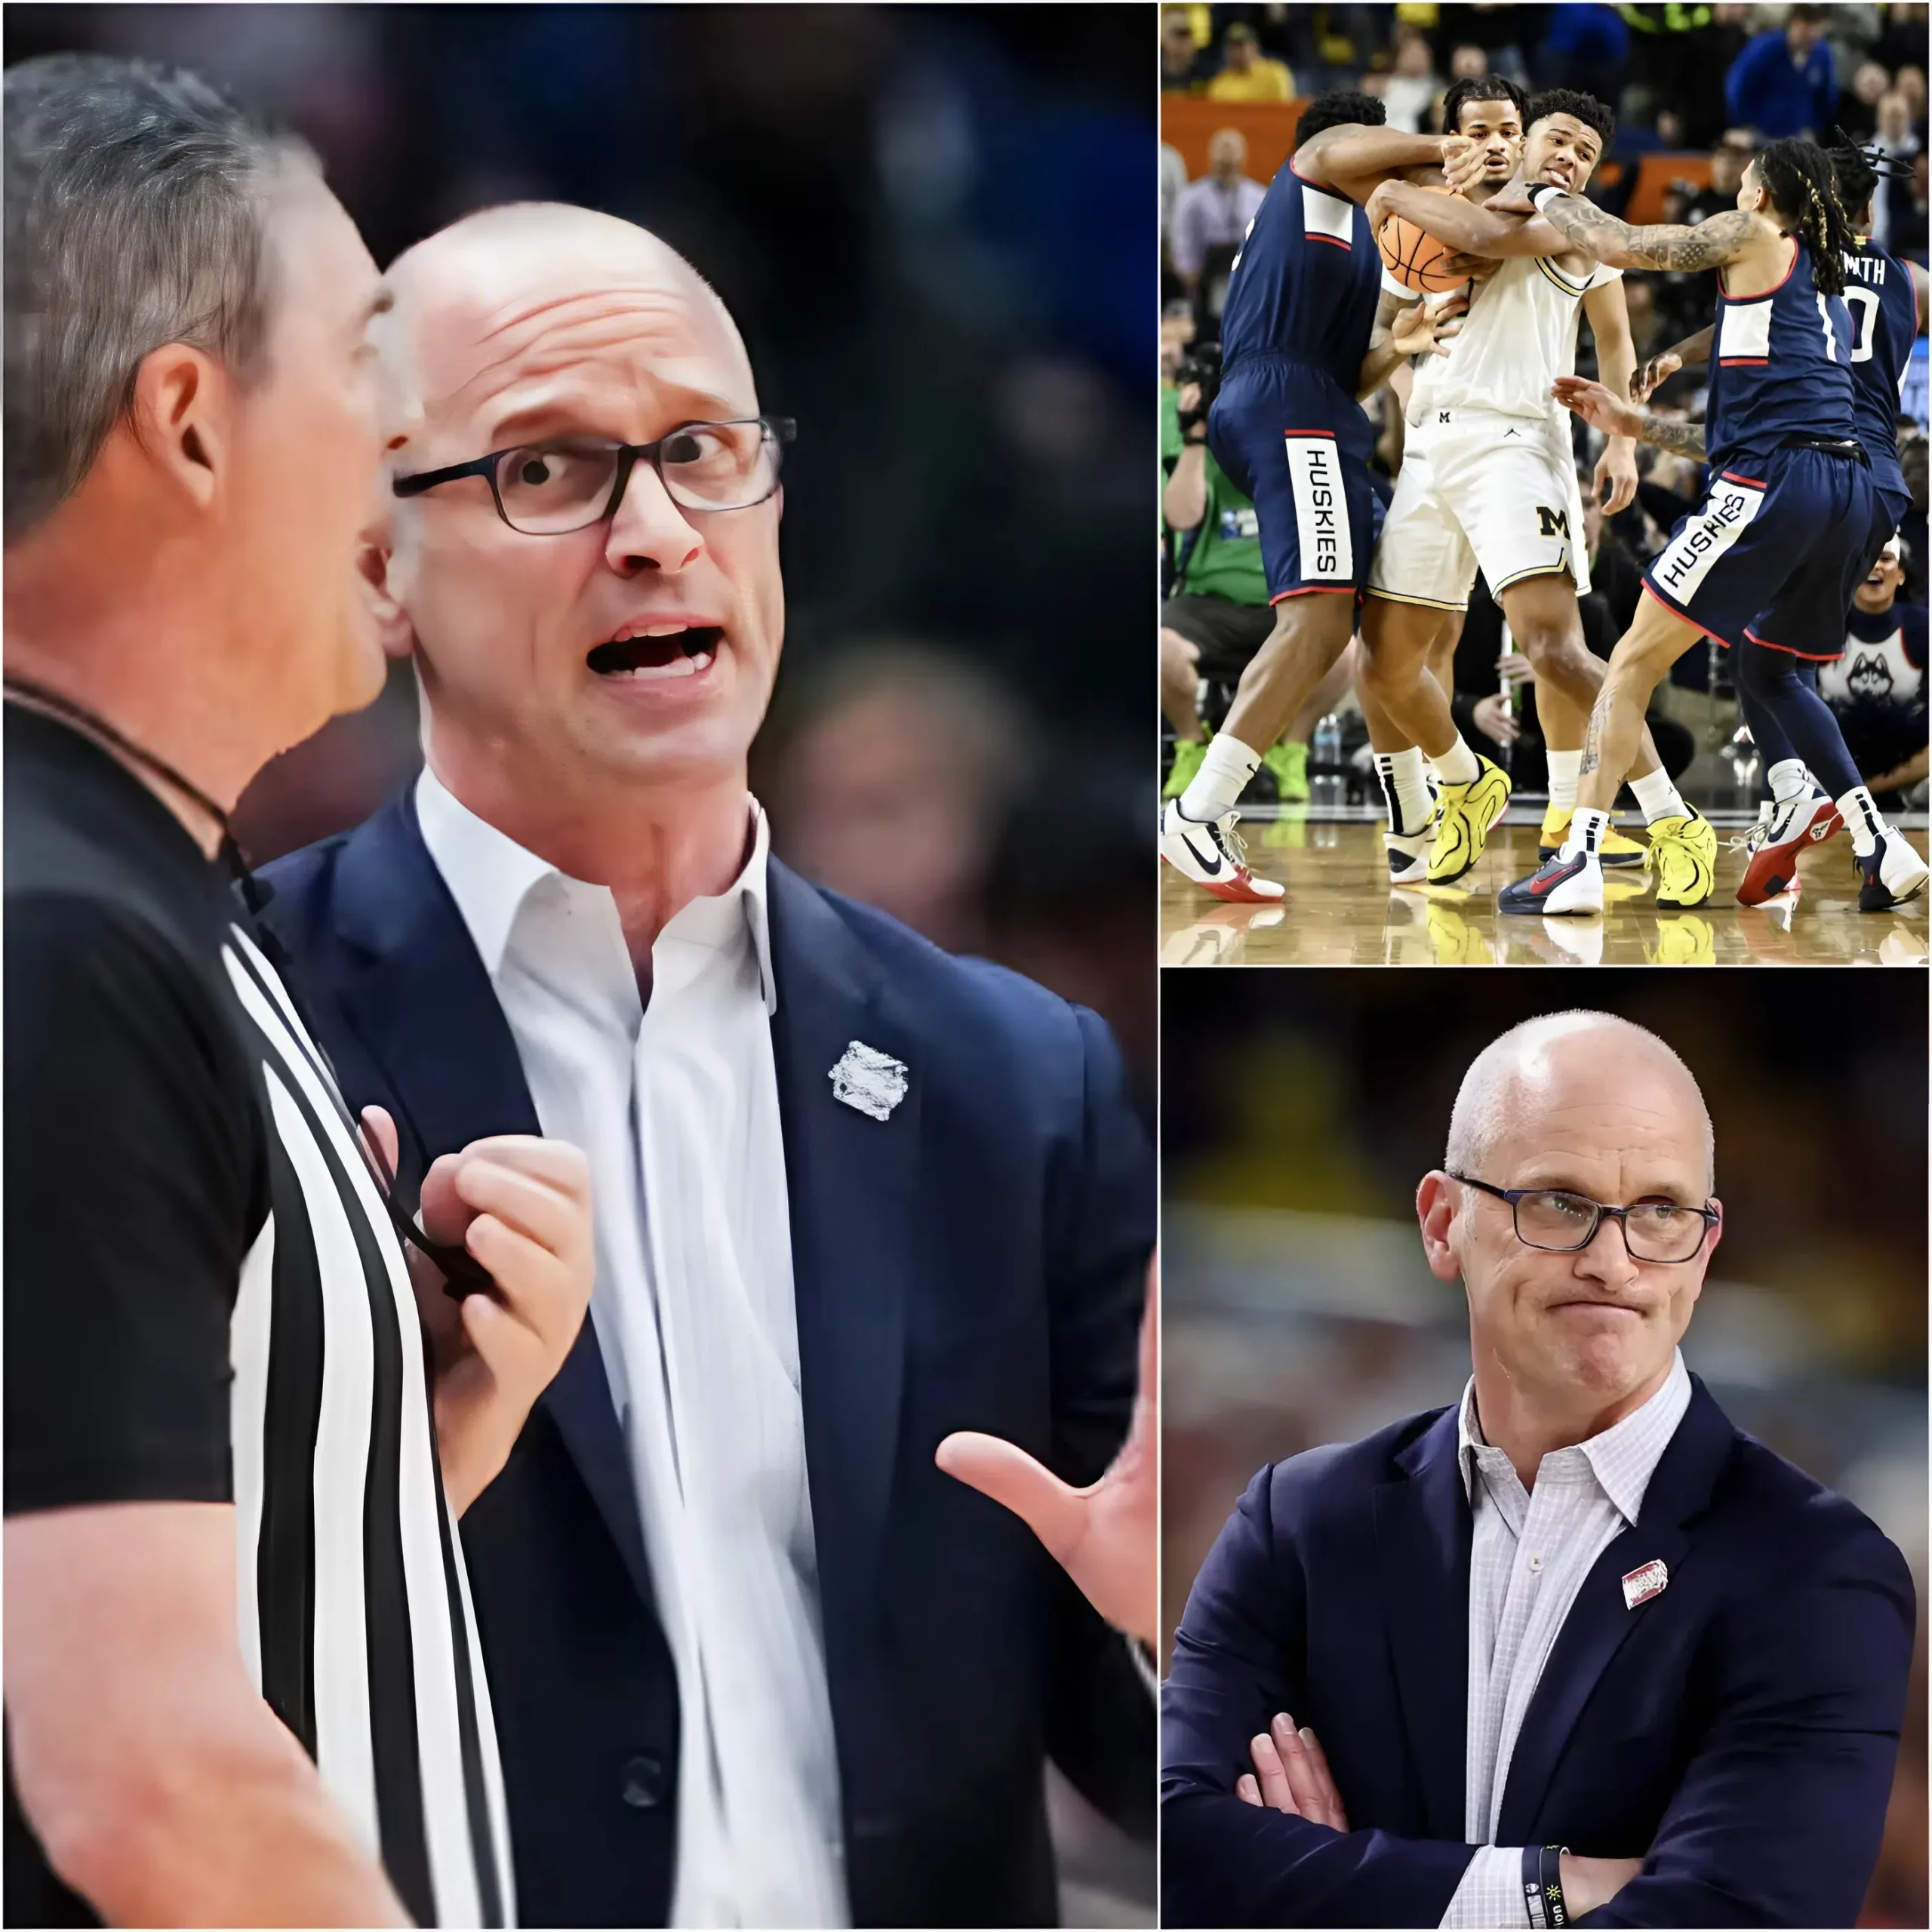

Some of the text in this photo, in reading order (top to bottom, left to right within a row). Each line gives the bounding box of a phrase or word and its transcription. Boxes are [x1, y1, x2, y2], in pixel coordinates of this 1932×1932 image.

[1839, 249, 1885, 285] MITH
[1439, 411, 1451, 423] M
[1306, 451, 1337, 572] HUSKIES
[1536, 506, 1571, 541] M
[1663, 494, 1745, 588] HUSKIES
